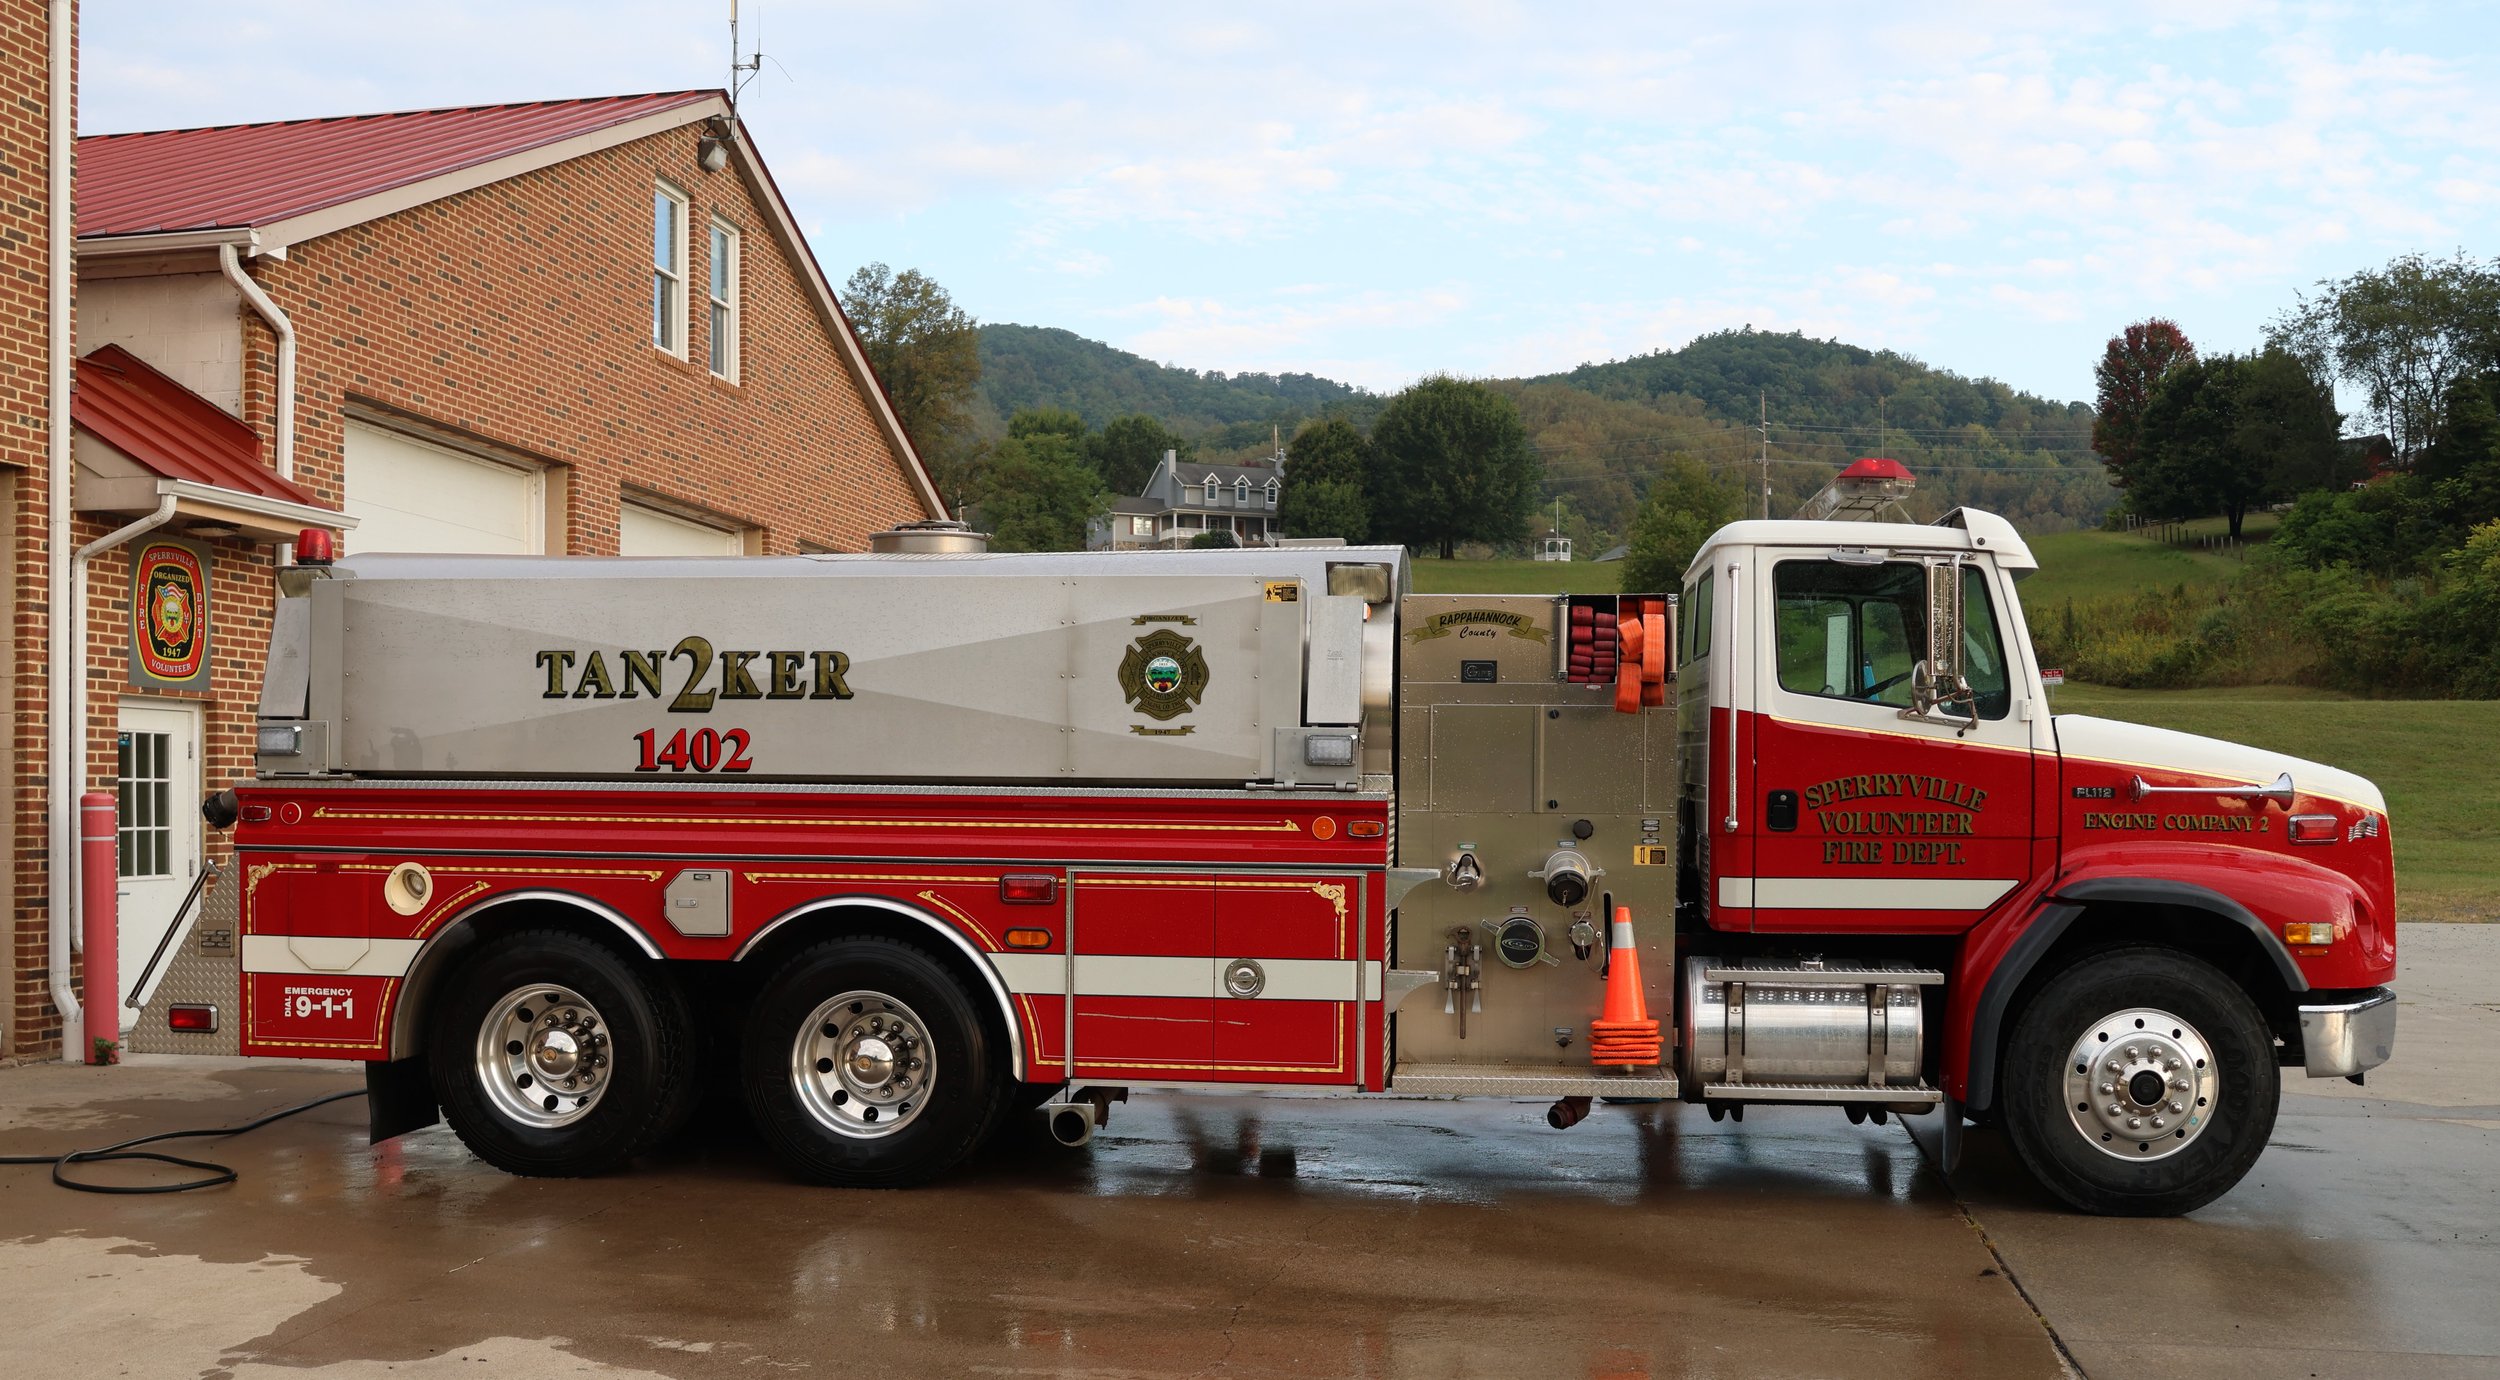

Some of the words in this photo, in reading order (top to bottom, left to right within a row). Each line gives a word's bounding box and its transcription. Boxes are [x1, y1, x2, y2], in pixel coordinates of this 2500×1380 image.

[148, 551, 194, 569] SPERRYVILLE
[153, 570, 190, 583] ORGANIZED
[1439, 611, 1522, 627] RAPPAHANNOCK
[1459, 626, 1497, 639] County
[162, 647, 181, 658] 1947
[151, 658, 192, 673] VOLUNTEER
[536, 635, 855, 713] TAN2KER
[633, 727, 753, 773] 1402
[1804, 773, 1989, 812] SPERRYVILLE
[1817, 811, 1975, 836] VOLUNTEER
[2084, 812, 2157, 831] ENGINE
[2164, 814, 2254, 832] COMPANY
[2259, 815, 2269, 833] 2
[1822, 840, 1883, 865] FIRE
[1892, 841, 1966, 865] DEPT.
[284, 986, 353, 996] EMERGENCY
[284, 995, 292, 1017] DIAL
[295, 995, 353, 1019] 9-1-1
